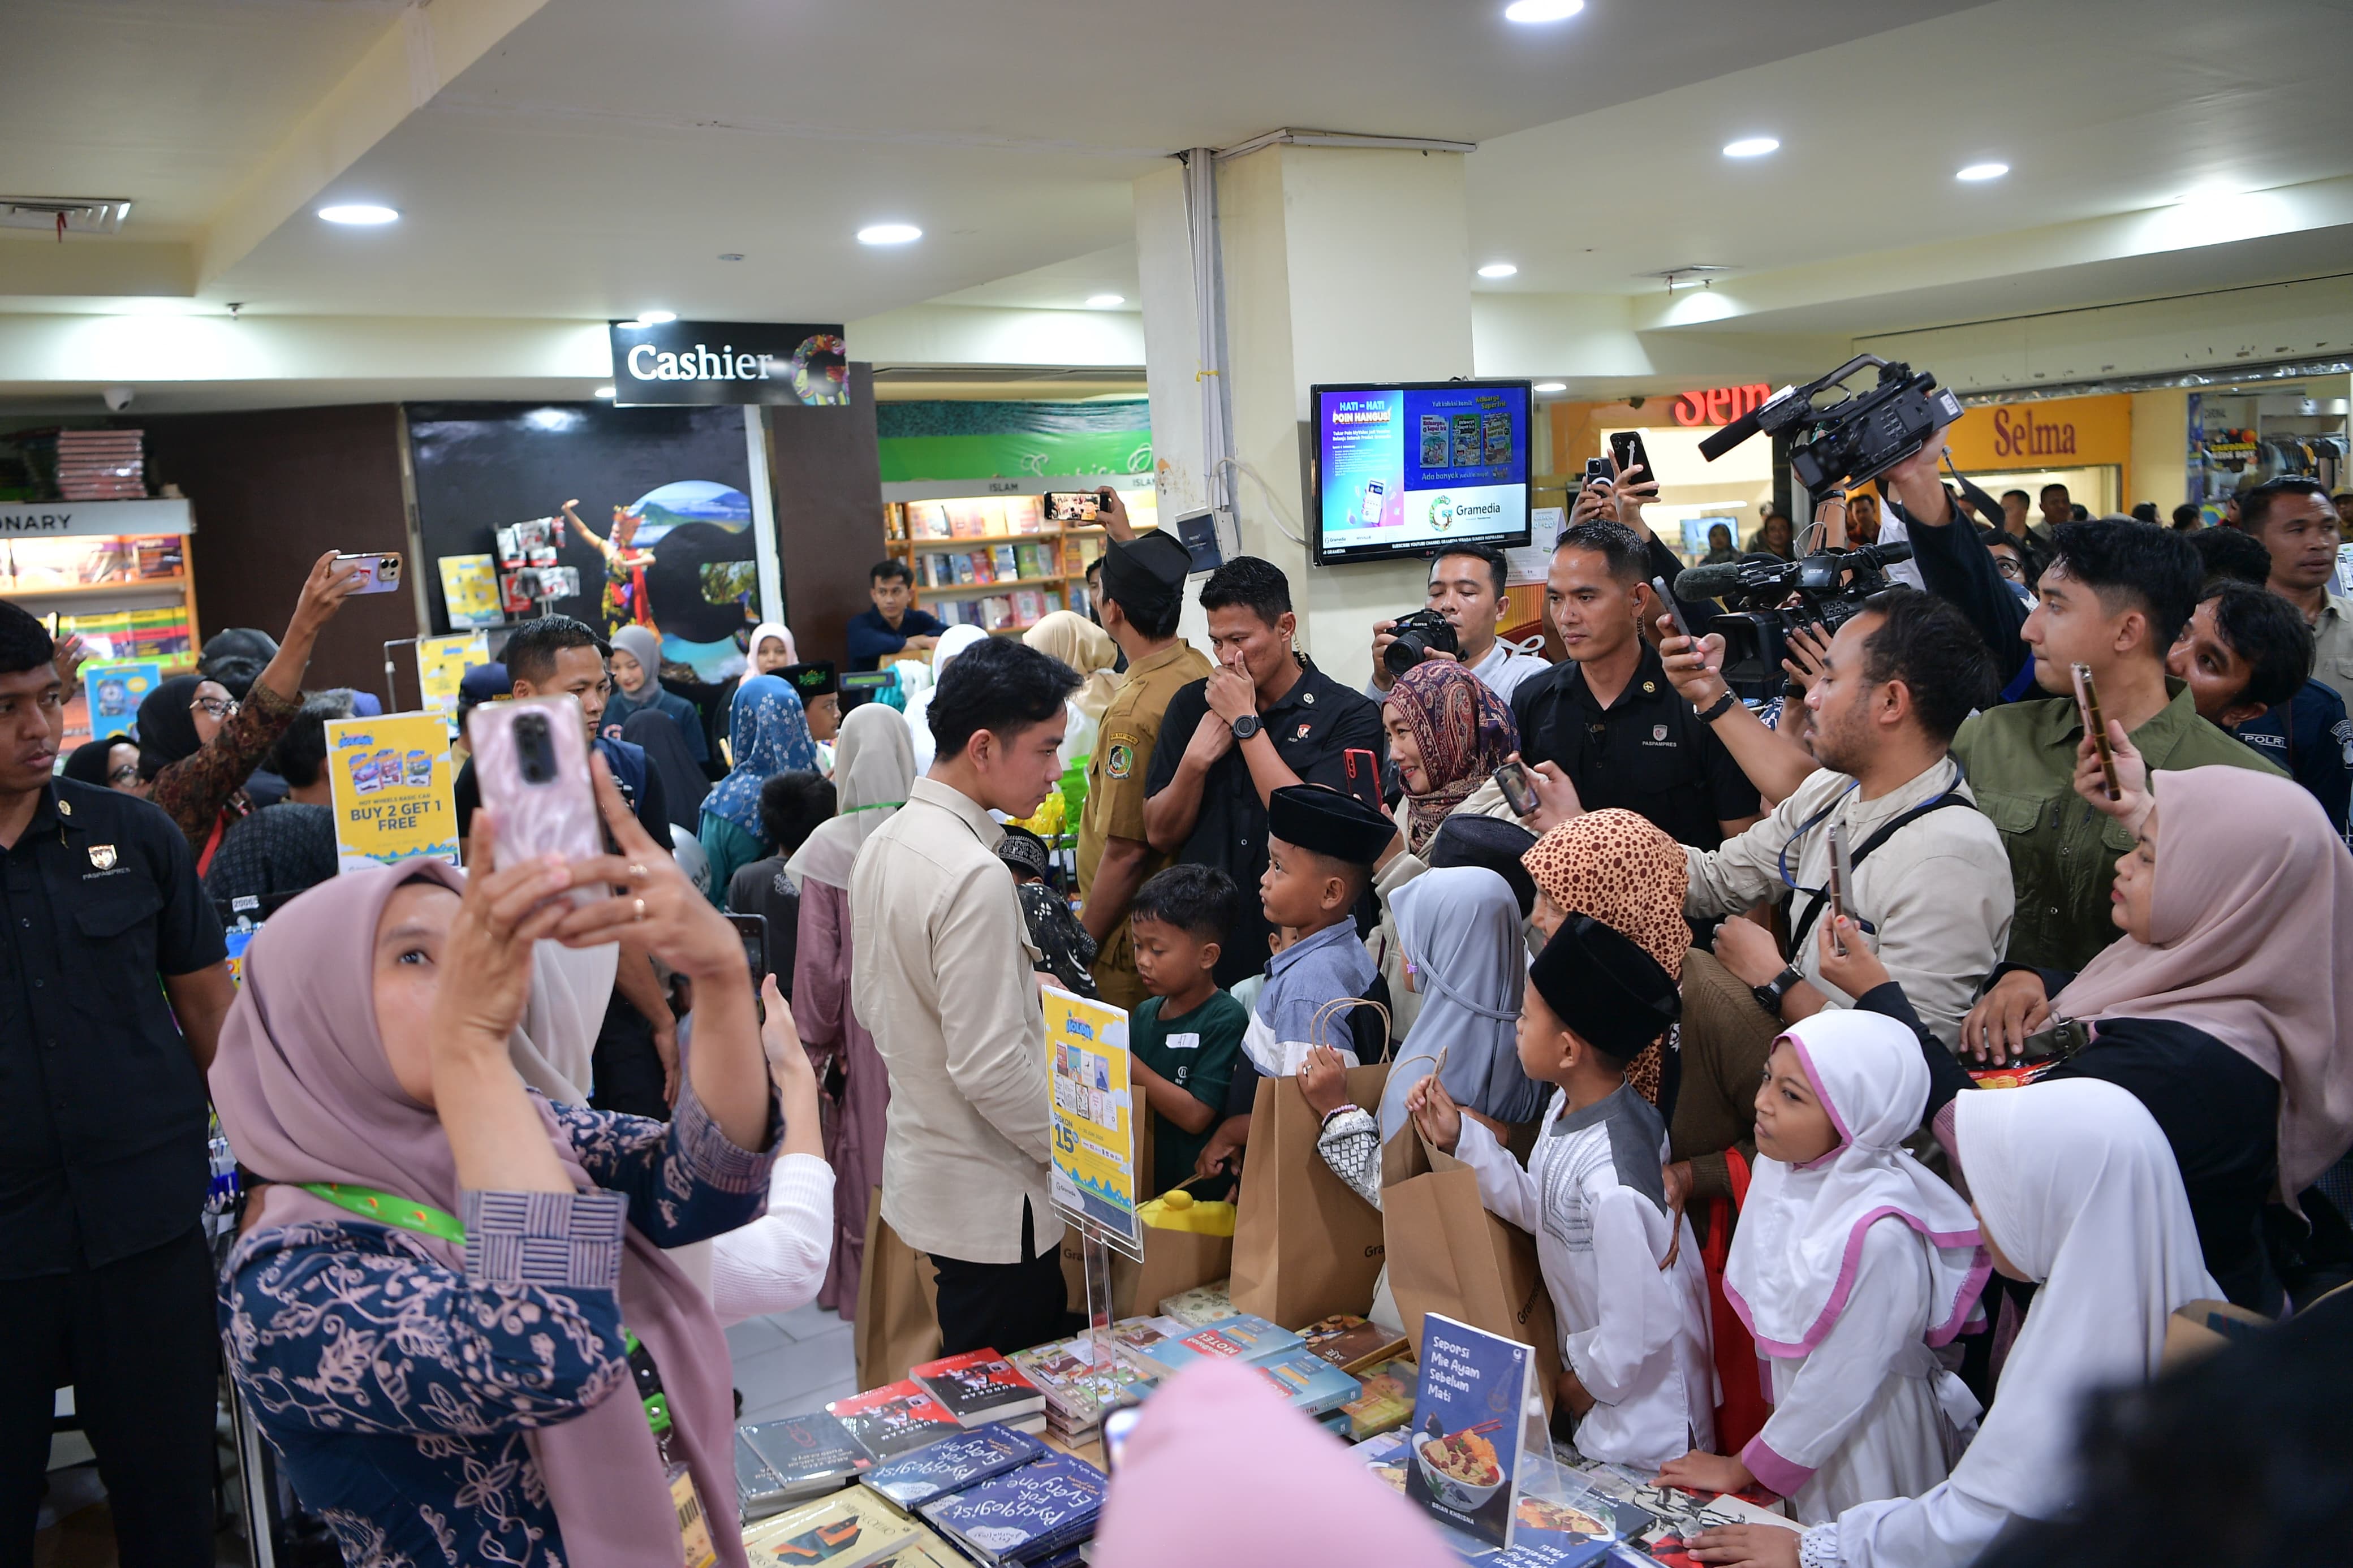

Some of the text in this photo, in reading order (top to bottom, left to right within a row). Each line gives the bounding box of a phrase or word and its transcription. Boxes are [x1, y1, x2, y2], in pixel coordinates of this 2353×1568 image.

[627, 344, 774, 381] Cashier
[1339, 401, 1358, 411] HATI
[1366, 400, 1385, 410] HATI
[1333, 413, 1353, 424] POIN
[1994, 408, 2076, 456] Selma
[1436, 472, 1458, 480] banyak
[1456, 502, 1501, 516] Gramedia
[2244, 735, 2285, 746] POLRI
[351, 800, 441, 821] BUY 2 GET 1
[378, 816, 417, 831] FREE
[1054, 1112, 1073, 1128] DISKON
[1199, 1333, 1238, 1354] MOTEL
[1433, 1336, 1470, 1359] Seporsi
[1431, 1351, 1480, 1379] Mie Ayam
[1430, 1368, 1469, 1392] Sebelum
[1428, 1384, 1451, 1403] Mati
[875, 1461, 977, 1481] Psychologist
[1018, 1490, 1050, 1504] FOR
[954, 1500, 1066, 1526] Psychologist
[1432, 1502, 1475, 1525] BRIAN KHRISNA
[1512, 1544, 1557, 1565] Sebelum
[1540, 1544, 1569, 1559] Mati
